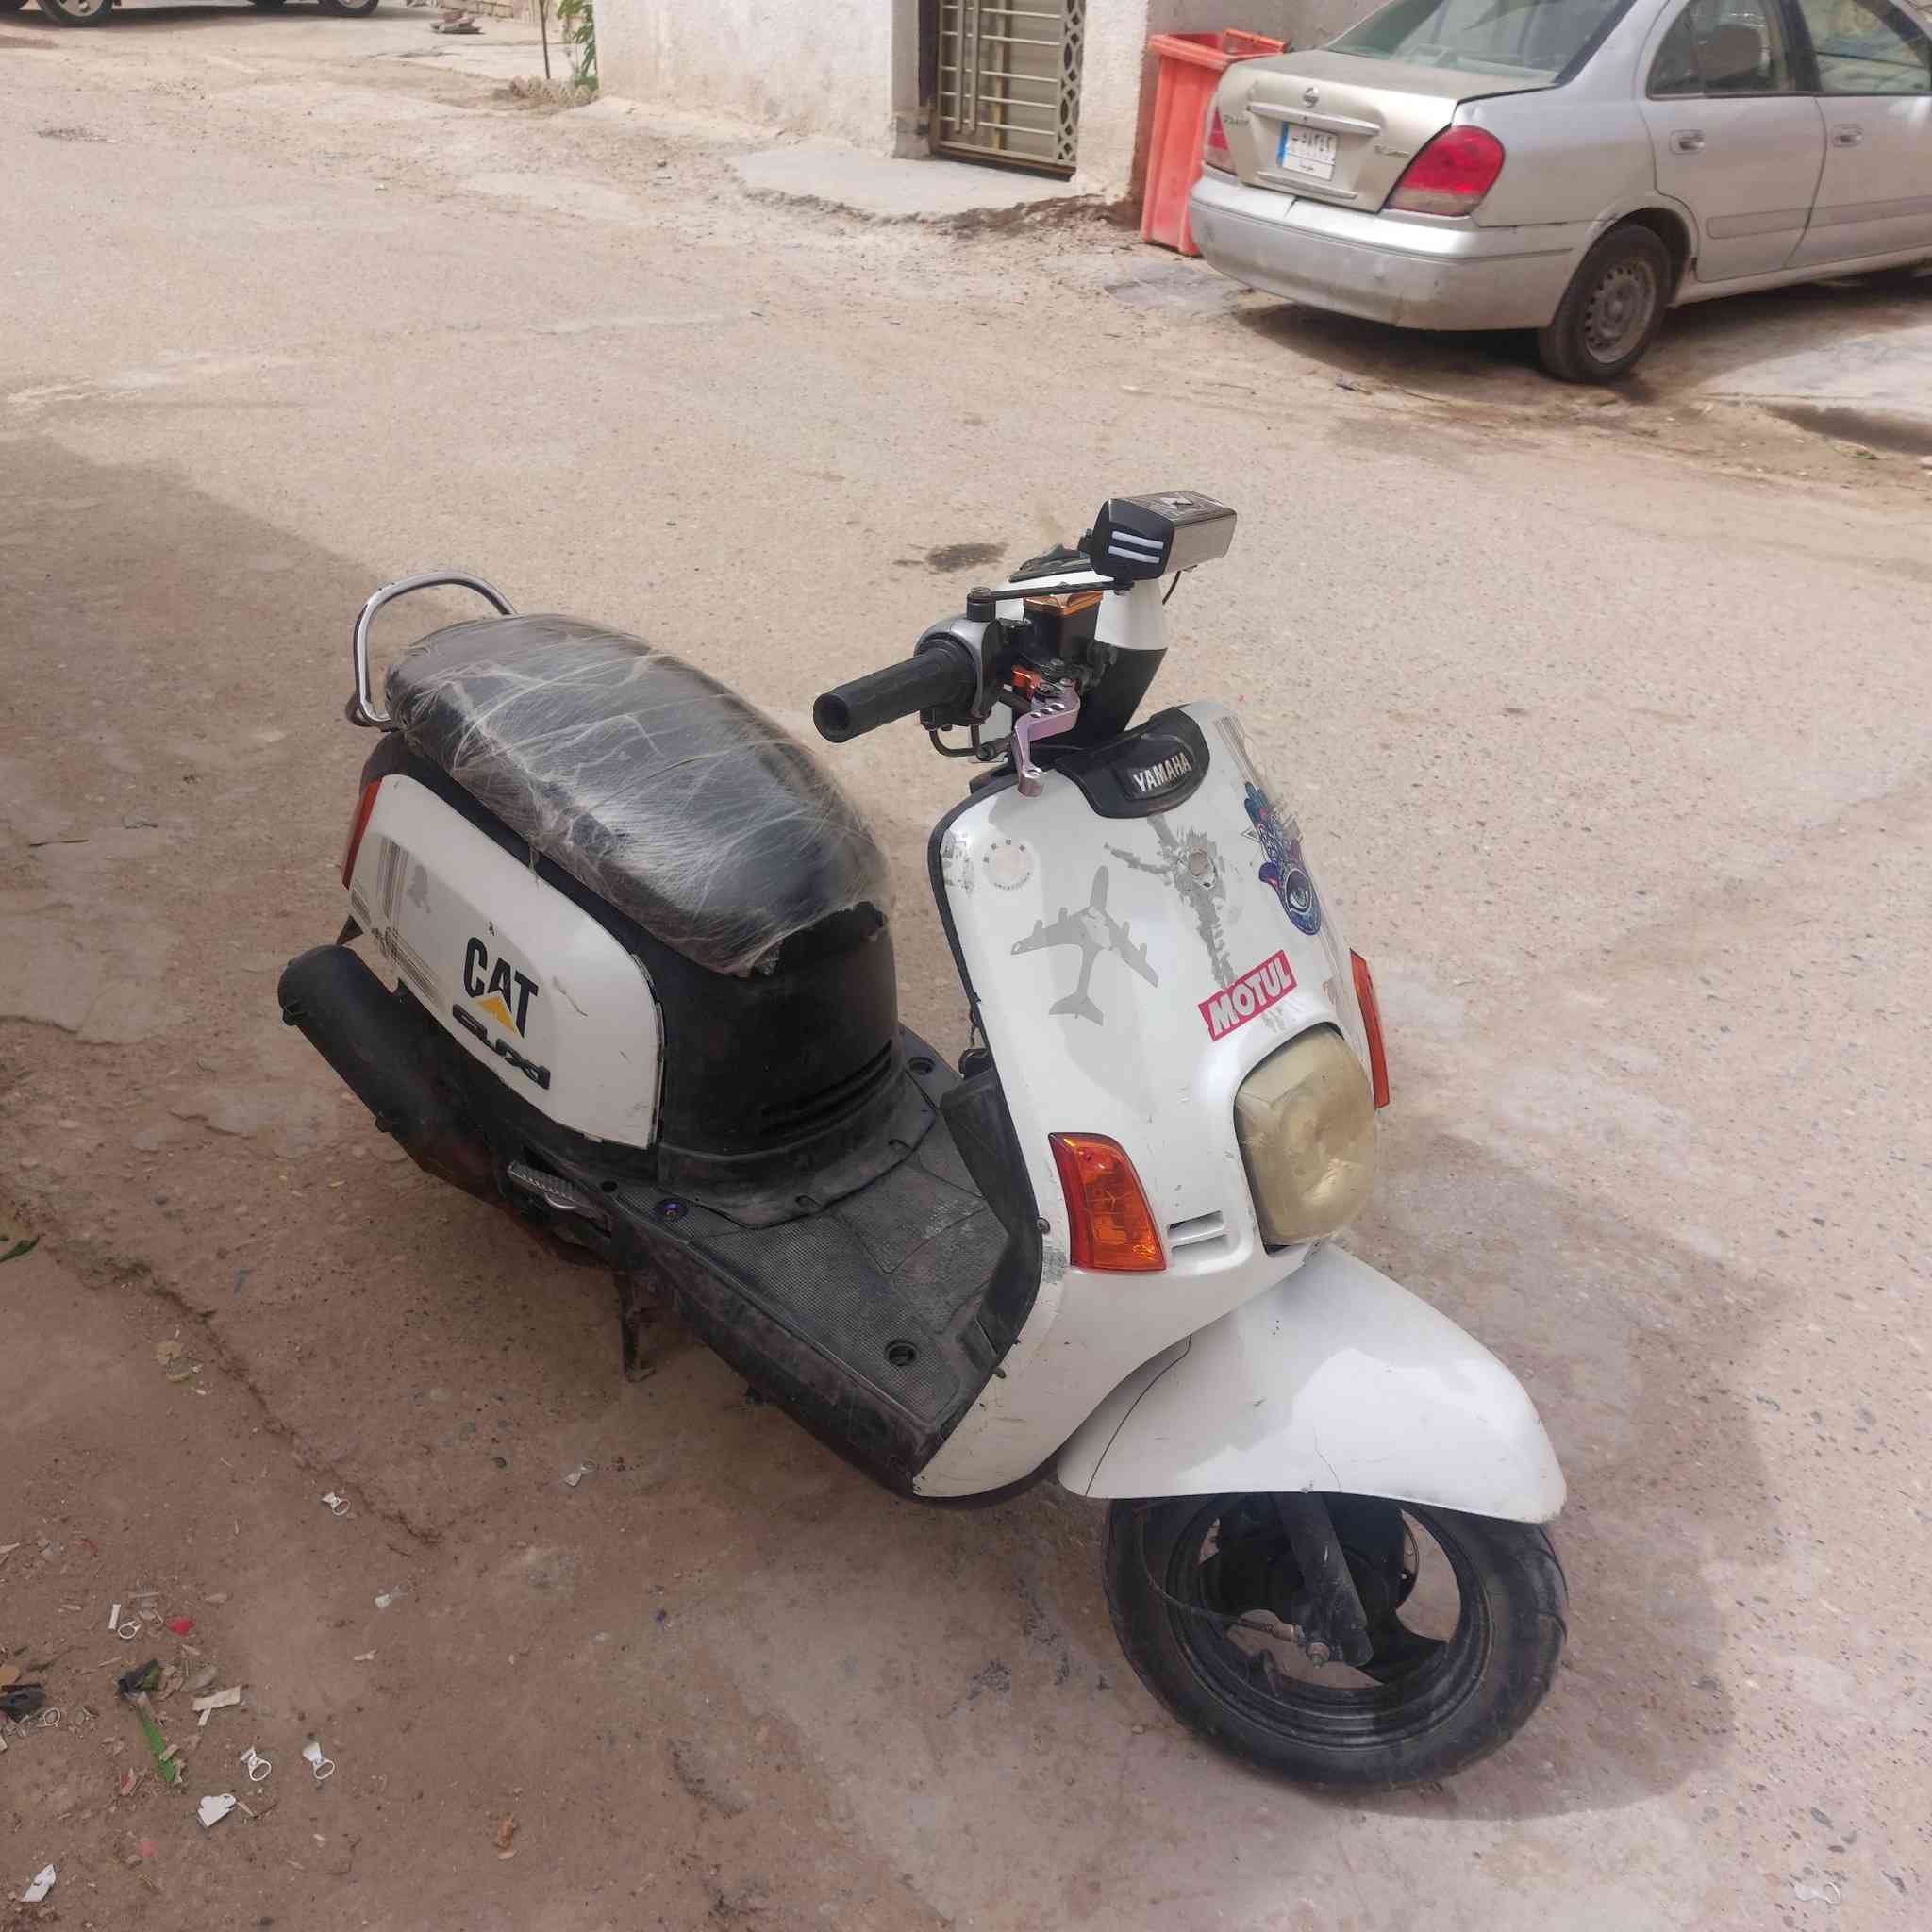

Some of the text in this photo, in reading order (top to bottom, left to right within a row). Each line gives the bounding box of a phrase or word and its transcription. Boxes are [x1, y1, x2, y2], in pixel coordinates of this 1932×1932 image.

[1133, 752, 1192, 792] YAMAHA
[463, 936, 540, 1039] CAT
[1208, 957, 1291, 1037] MOTUL
